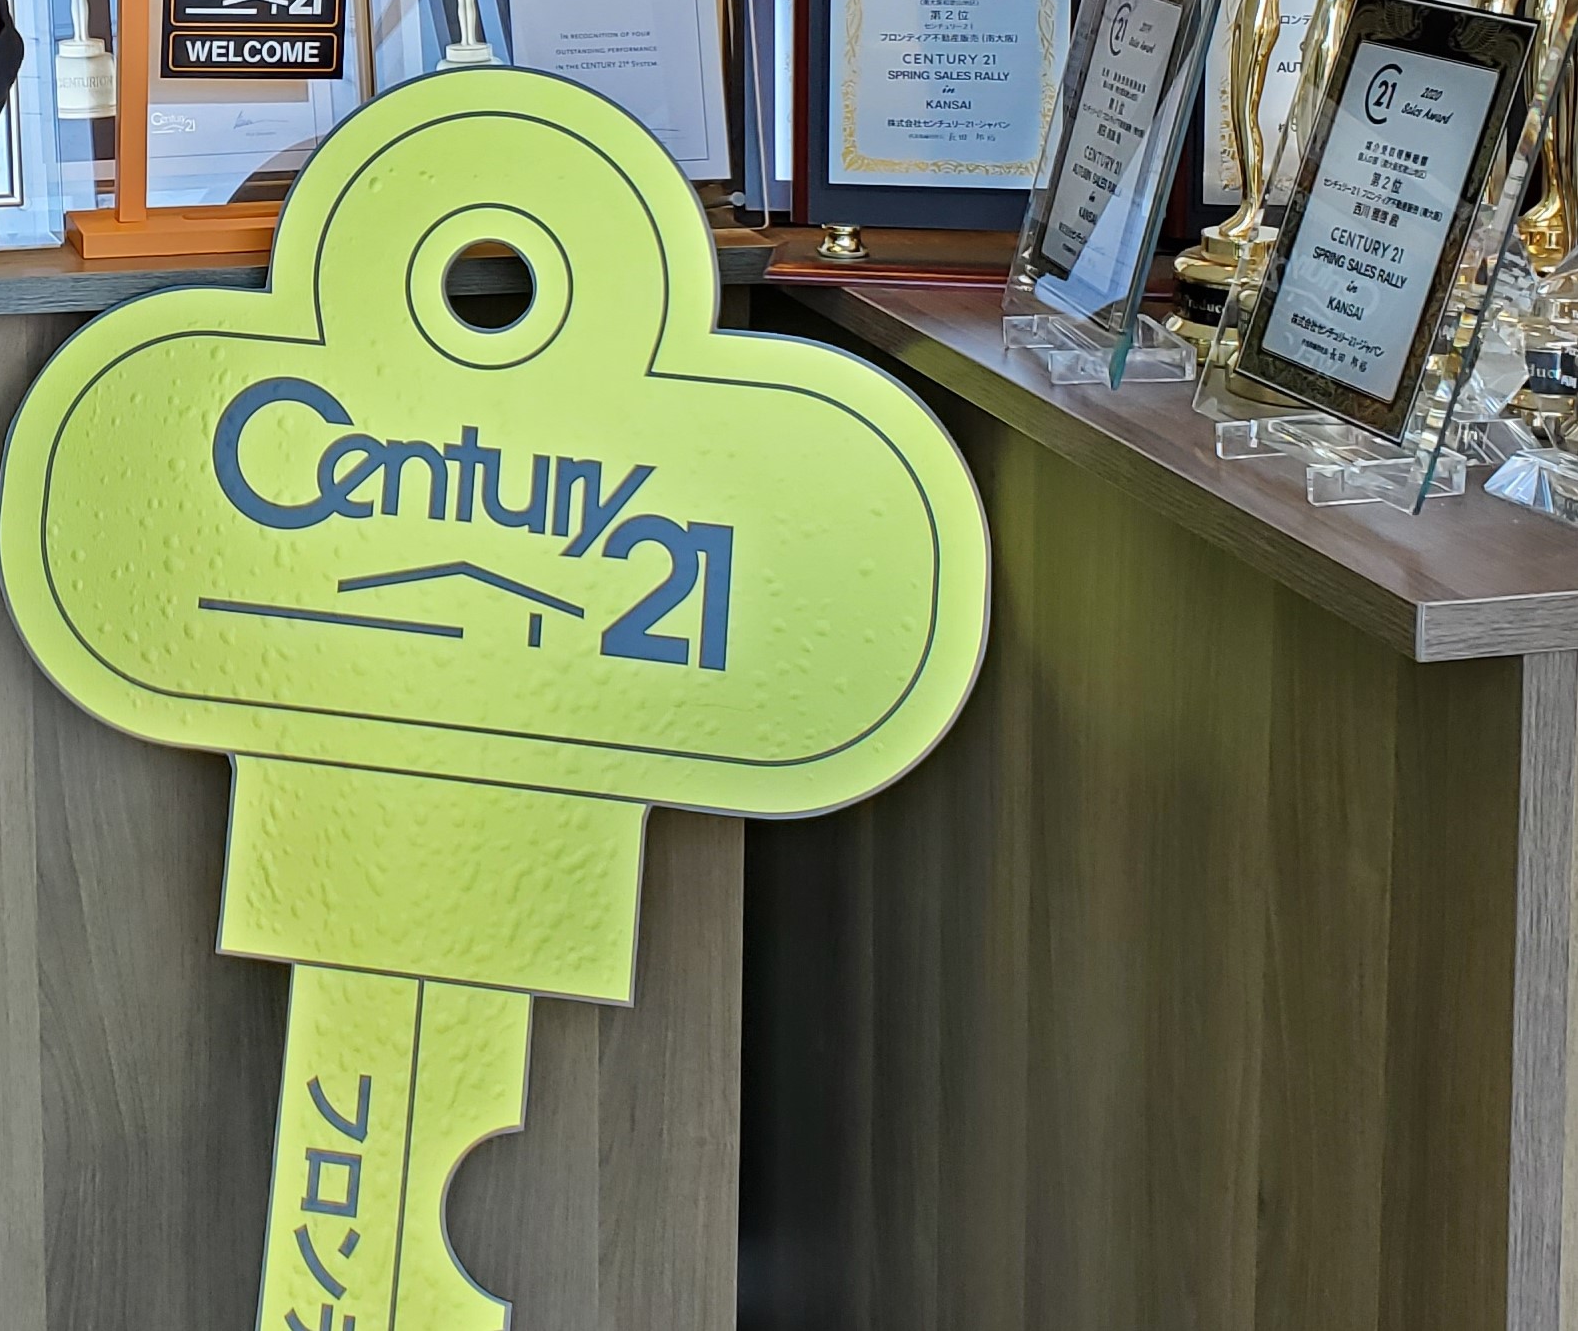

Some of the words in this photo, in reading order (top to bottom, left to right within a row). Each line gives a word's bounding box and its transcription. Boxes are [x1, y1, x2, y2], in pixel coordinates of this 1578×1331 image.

[930, 10, 970, 21] 第2位
[185, 40, 321, 63] WELCOME
[902, 53, 979, 65] CENTURY
[982, 54, 997, 65] 21
[580, 61, 616, 70] CENTURY
[887, 70, 930, 80] SPRING
[934, 70, 972, 81] SALES
[974, 71, 1010, 81] RALLY
[942, 85, 955, 94] in
[925, 99, 972, 110] KANSAI
[1424, 107, 1455, 125] Award
[1370, 171, 1403, 195] 第2位
[1330, 226, 1391, 260] CENTURY
[1389, 246, 1405, 265] 21
[1312, 245, 1346, 269] SPRING
[1346, 258, 1378, 280] SALES
[1376, 269, 1408, 290] RALLY
[1346, 280, 1358, 294] in
[1326, 295, 1365, 321] KANSAI
[213, 375, 657, 557] Century
[600, 513, 734, 671] 21
